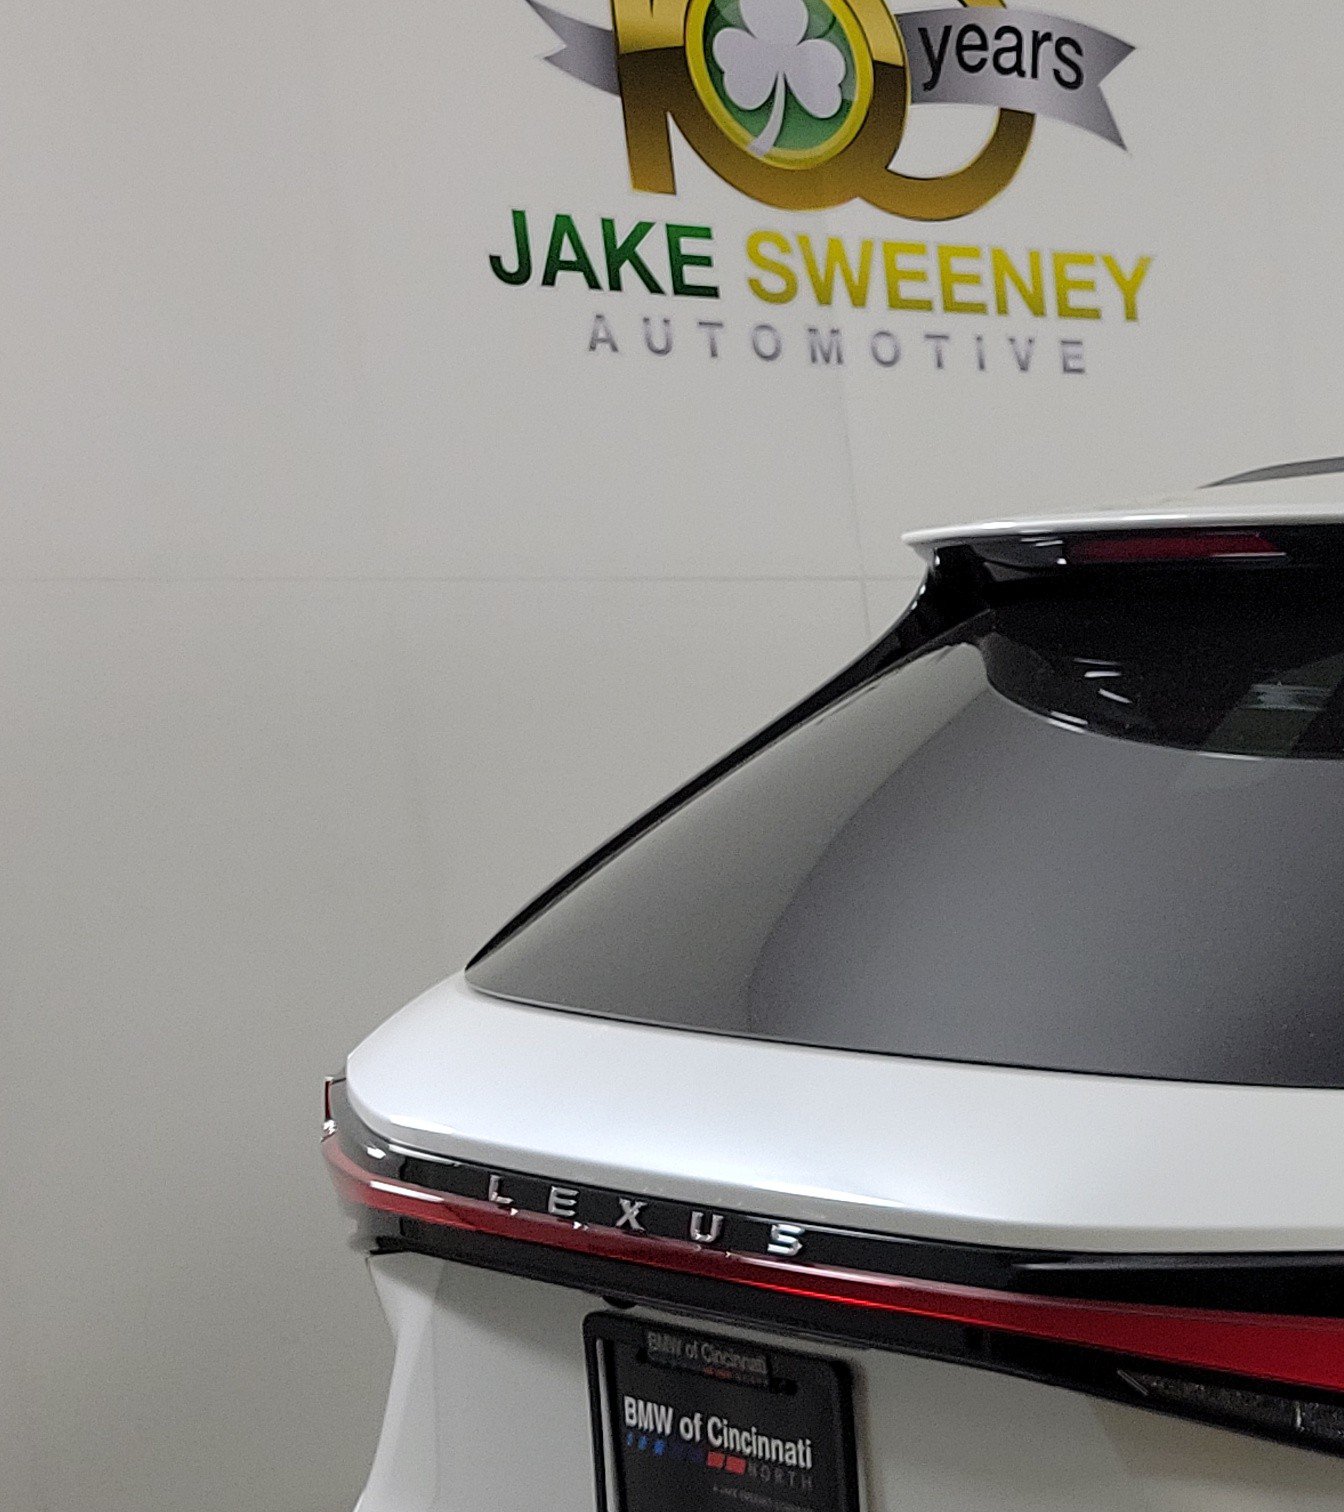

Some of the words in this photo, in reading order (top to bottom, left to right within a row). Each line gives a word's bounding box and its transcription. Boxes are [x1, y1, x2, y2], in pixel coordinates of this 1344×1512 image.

[917, 21, 1085, 92] years
[488, 208, 721, 299] JAKE
[745, 229, 1155, 323] SWEENEY
[586, 313, 1087, 376] AUTOMOTIVE
[487, 1173, 805, 1258] LEXUS
[623, 1395, 674, 1437] BMW
[679, 1412, 703, 1442] of
[707, 1416, 813, 1470] Cincinnati
